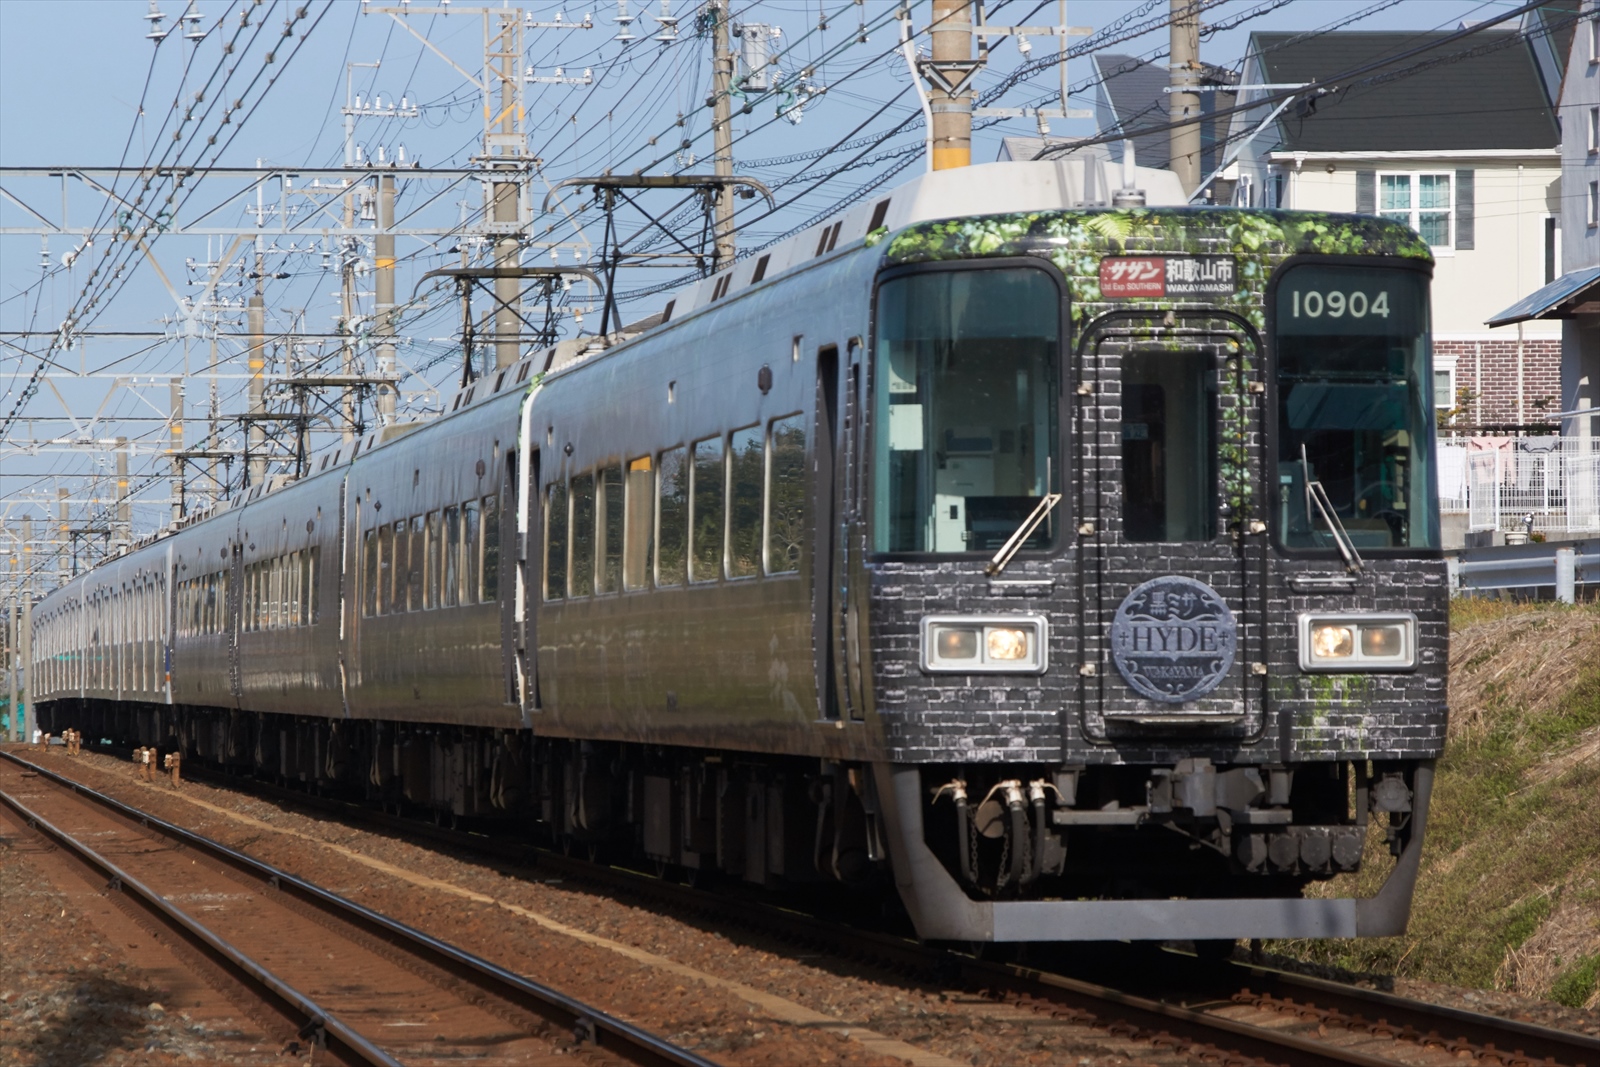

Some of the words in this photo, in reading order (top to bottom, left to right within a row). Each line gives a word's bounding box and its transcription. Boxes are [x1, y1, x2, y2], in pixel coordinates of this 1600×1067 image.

[1110, 260, 1161, 280] サザン
[1166, 258, 1234, 282] 和歌山市
[1113, 283, 1125, 291] Exp
[1126, 282, 1162, 291] SOUTHERN
[1165, 283, 1234, 293] WAKAYAMASHI
[1293, 290, 1390, 318] 10904
[1150, 591, 1198, 616] 黒ミサ
[1132, 626, 1218, 652] HYDE
[1142, 665, 1205, 679] WAKAYAMA
